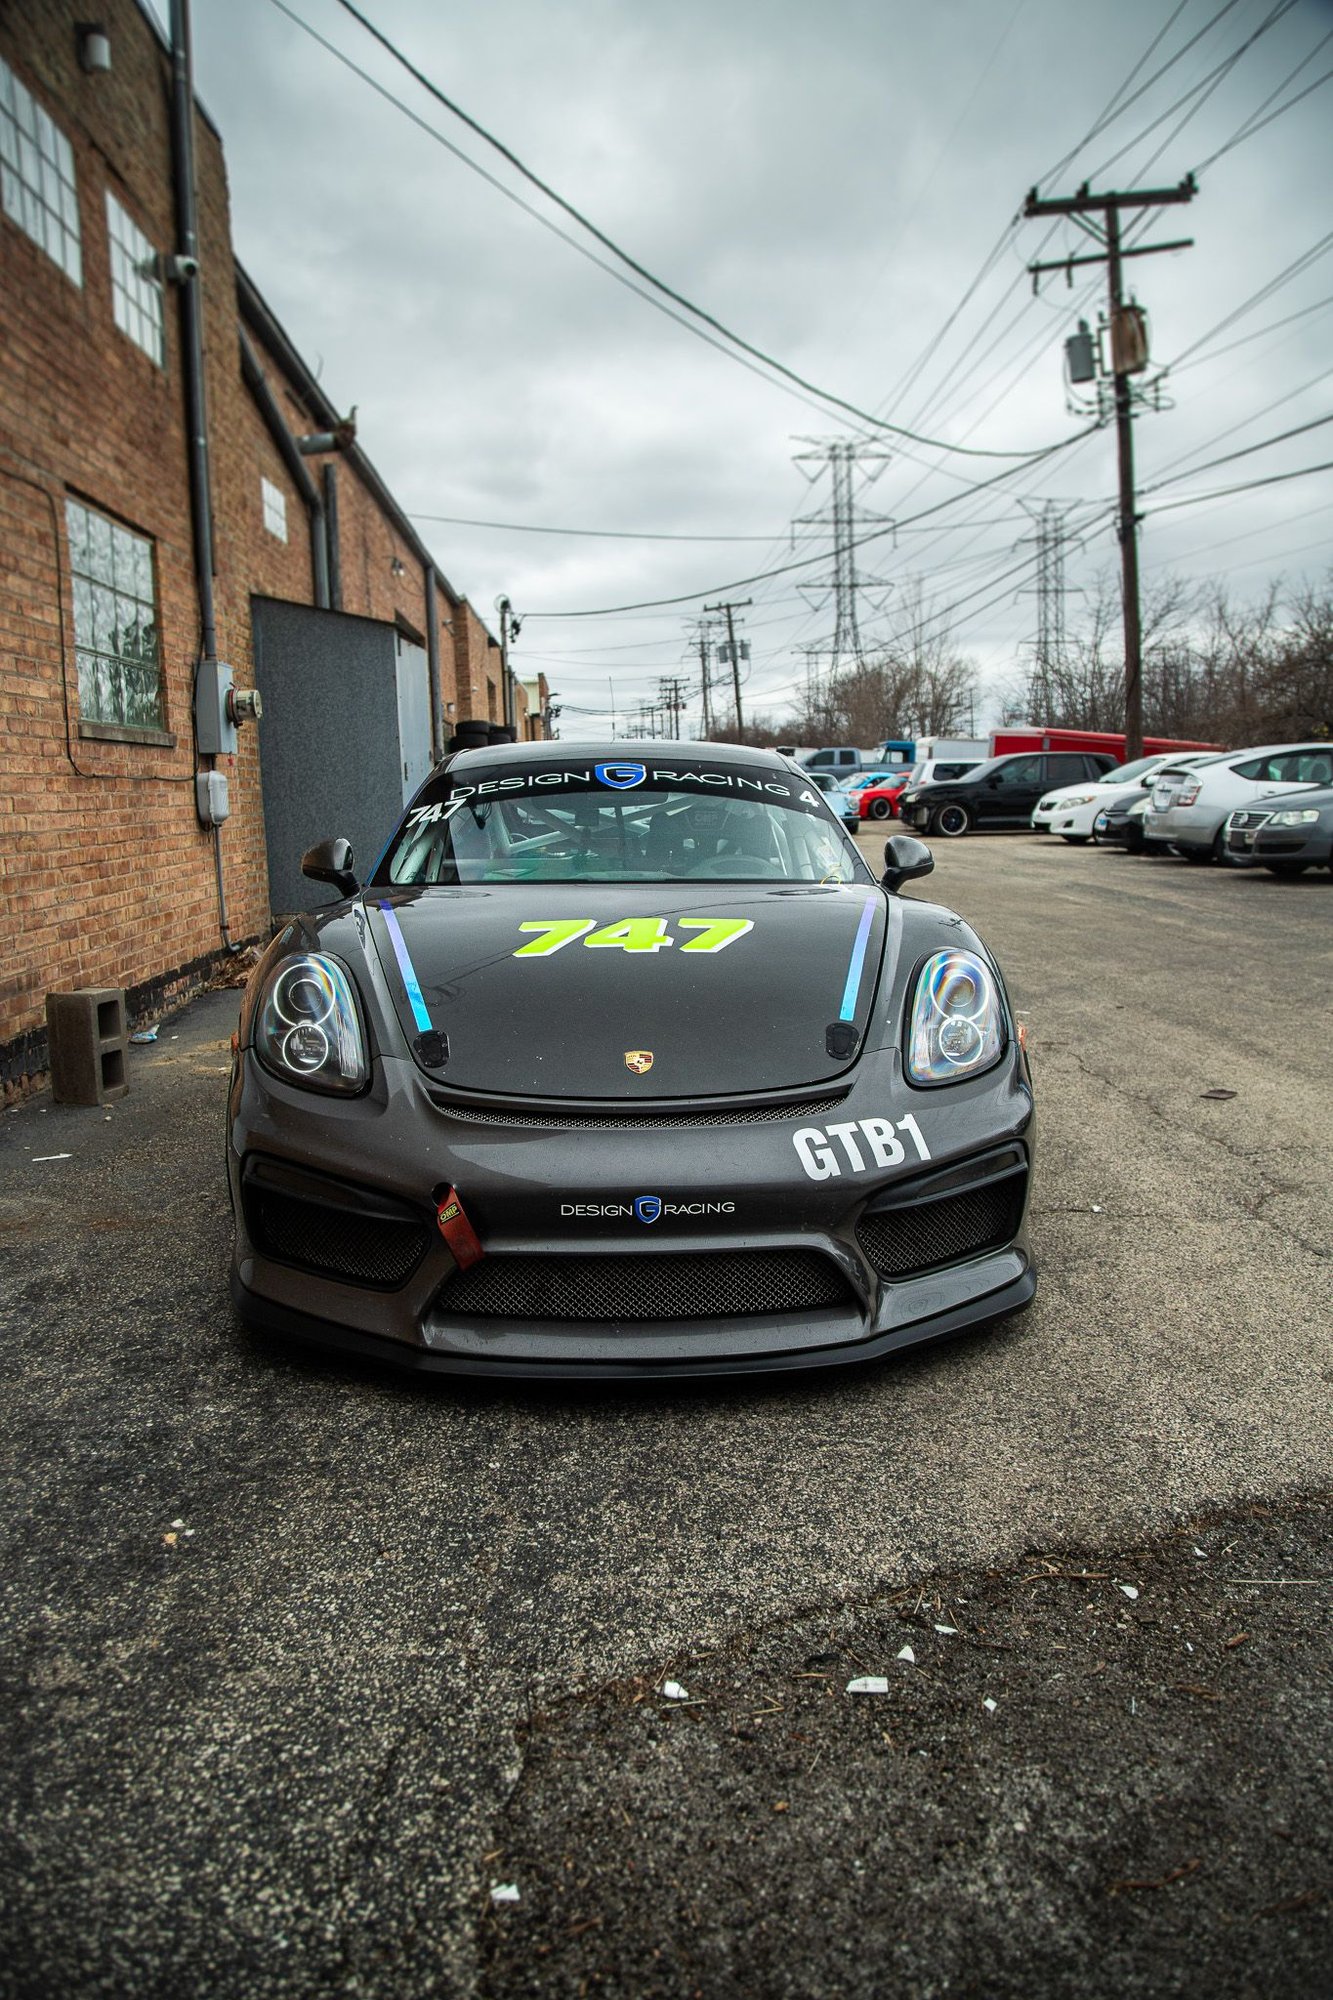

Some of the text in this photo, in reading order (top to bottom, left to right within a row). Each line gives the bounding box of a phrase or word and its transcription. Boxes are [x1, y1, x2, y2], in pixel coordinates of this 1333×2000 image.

[450, 771, 590, 801] DESIGN
[653, 771, 791, 797] RACING
[799, 790, 820, 807] 4
[405, 798, 467, 828] 747
[512, 918, 755, 957] 747
[792, 1113, 932, 1181] GTB1
[440, 1205, 458, 1221] OMP
[560, 1204, 633, 1216] DESIGN
[664, 1202, 736, 1215] RACING
